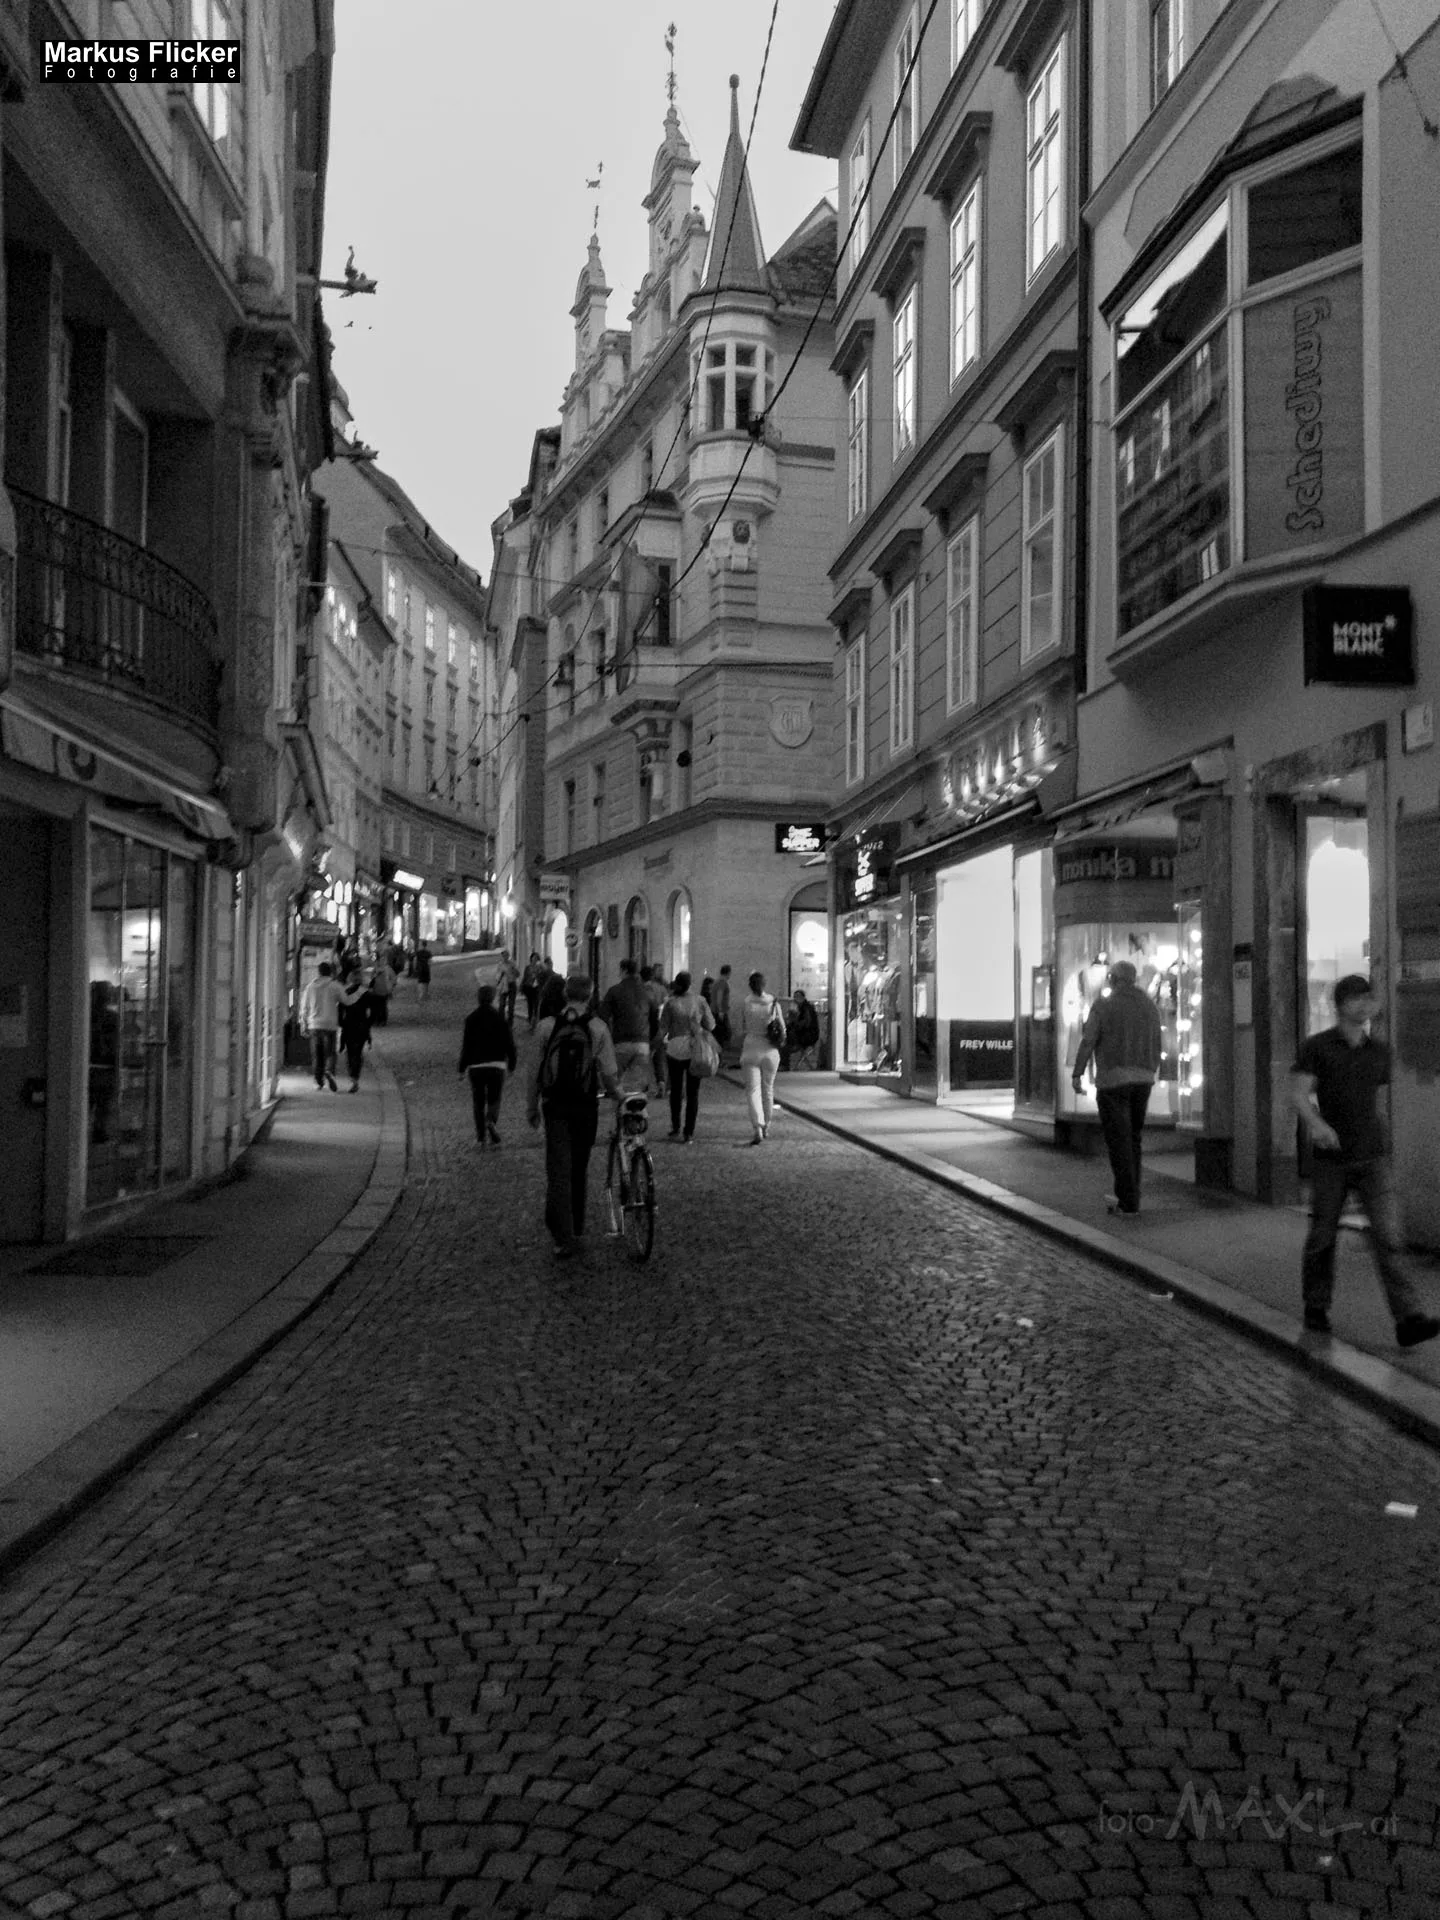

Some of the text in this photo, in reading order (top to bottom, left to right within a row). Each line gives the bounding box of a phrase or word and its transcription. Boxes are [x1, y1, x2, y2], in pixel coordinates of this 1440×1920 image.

[1284, 295, 1332, 534] Schediwy
[1333, 621, 1384, 638] MONT
[1333, 637, 1385, 656] BLANC
[960, 1039, 1014, 1051] FREY WILLE
